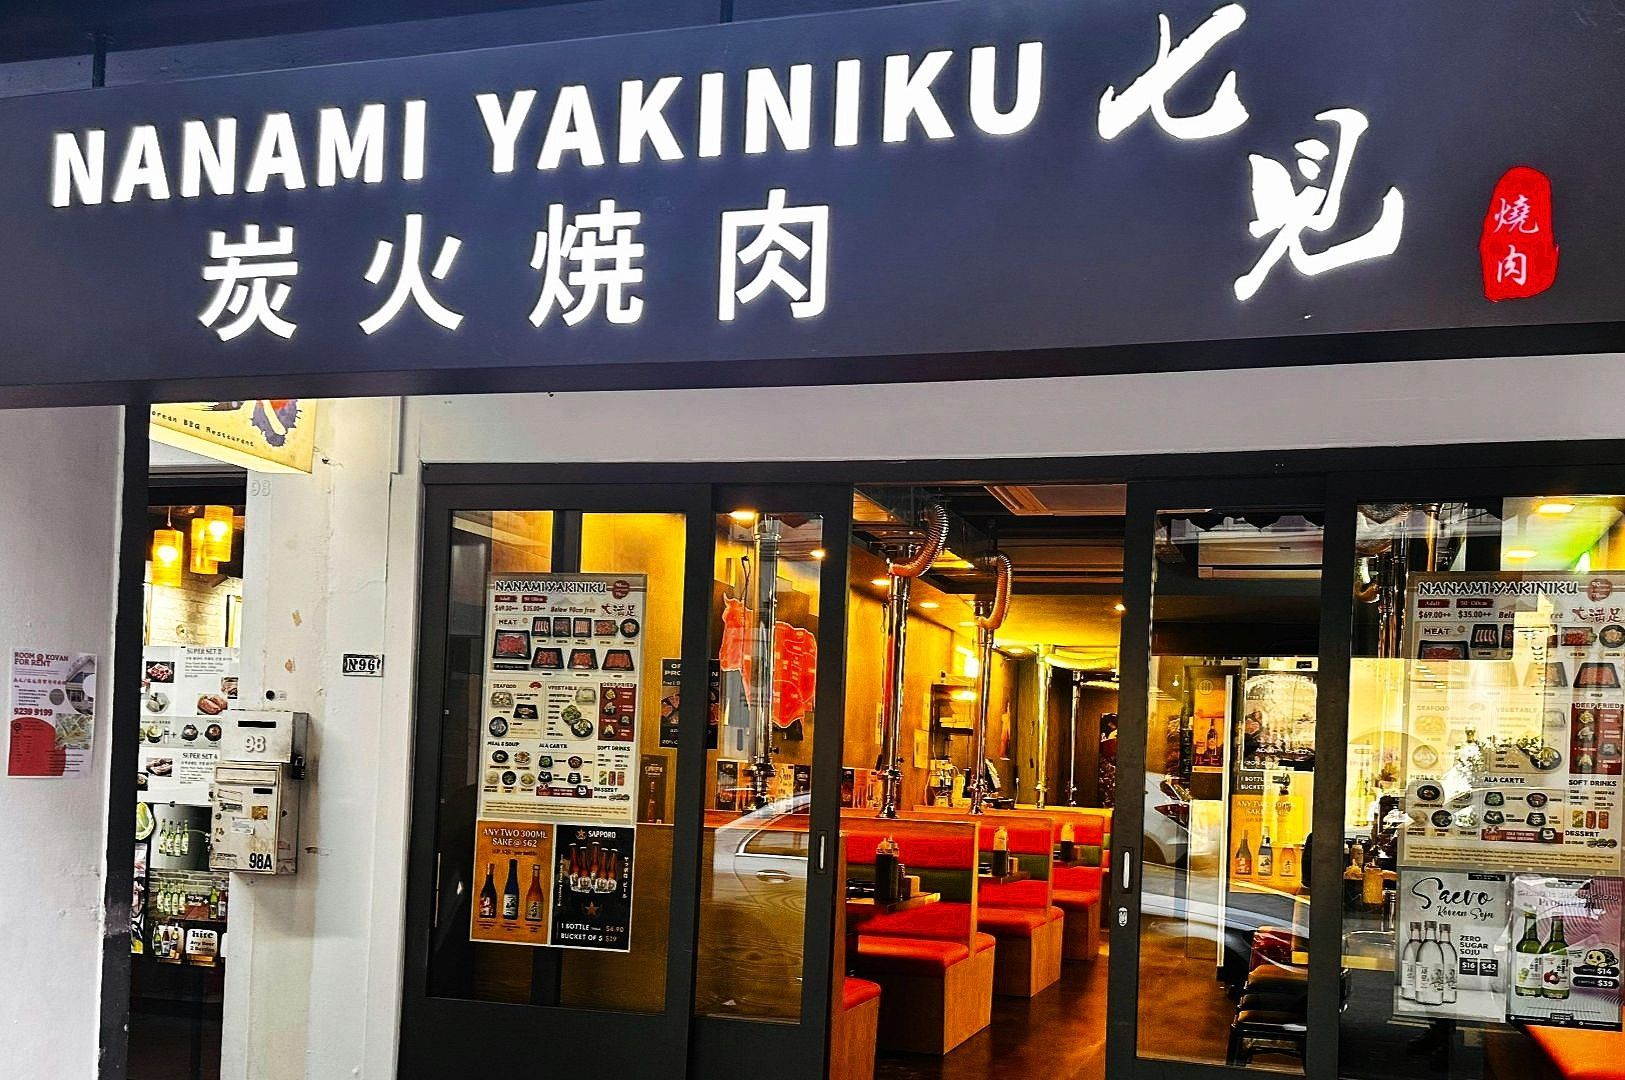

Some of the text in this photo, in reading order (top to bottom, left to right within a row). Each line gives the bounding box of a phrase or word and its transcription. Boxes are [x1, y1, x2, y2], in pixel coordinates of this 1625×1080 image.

[52, 41, 1043, 208] NANAMI YAKINIKU
[198, 188, 831, 342] 炭火焼肉
[495, 580, 607, 593] NANAMI YAKINIKU
[1419, 581, 1578, 595] NANAMI YAKINIKU
[1423, 627, 1450, 636] MEAT
[45, 654, 69, 662] KOVAN
[31, 660, 51, 668] RENT
[245, 735, 266, 753] 98
[483, 828, 548, 839] ANY TWO 300ML
[588, 830, 617, 839] SAPPORO
[1565, 830, 1600, 838] DESSERT
[492, 837, 512, 846] SAKE
[249, 852, 273, 870] 98A
[565, 923, 590, 931] BOTTLE
[560, 932, 587, 940] BUCKET
[1459, 934, 1481, 942] ZERO
[1459, 942, 1489, 950] SUGAR
[1459, 948, 1481, 956] SOJU
[1461, 961, 1476, 970] $16
[1481, 962, 1497, 970] $42
[1596, 967, 1612, 975] $14
[1597, 979, 1614, 987] $39
